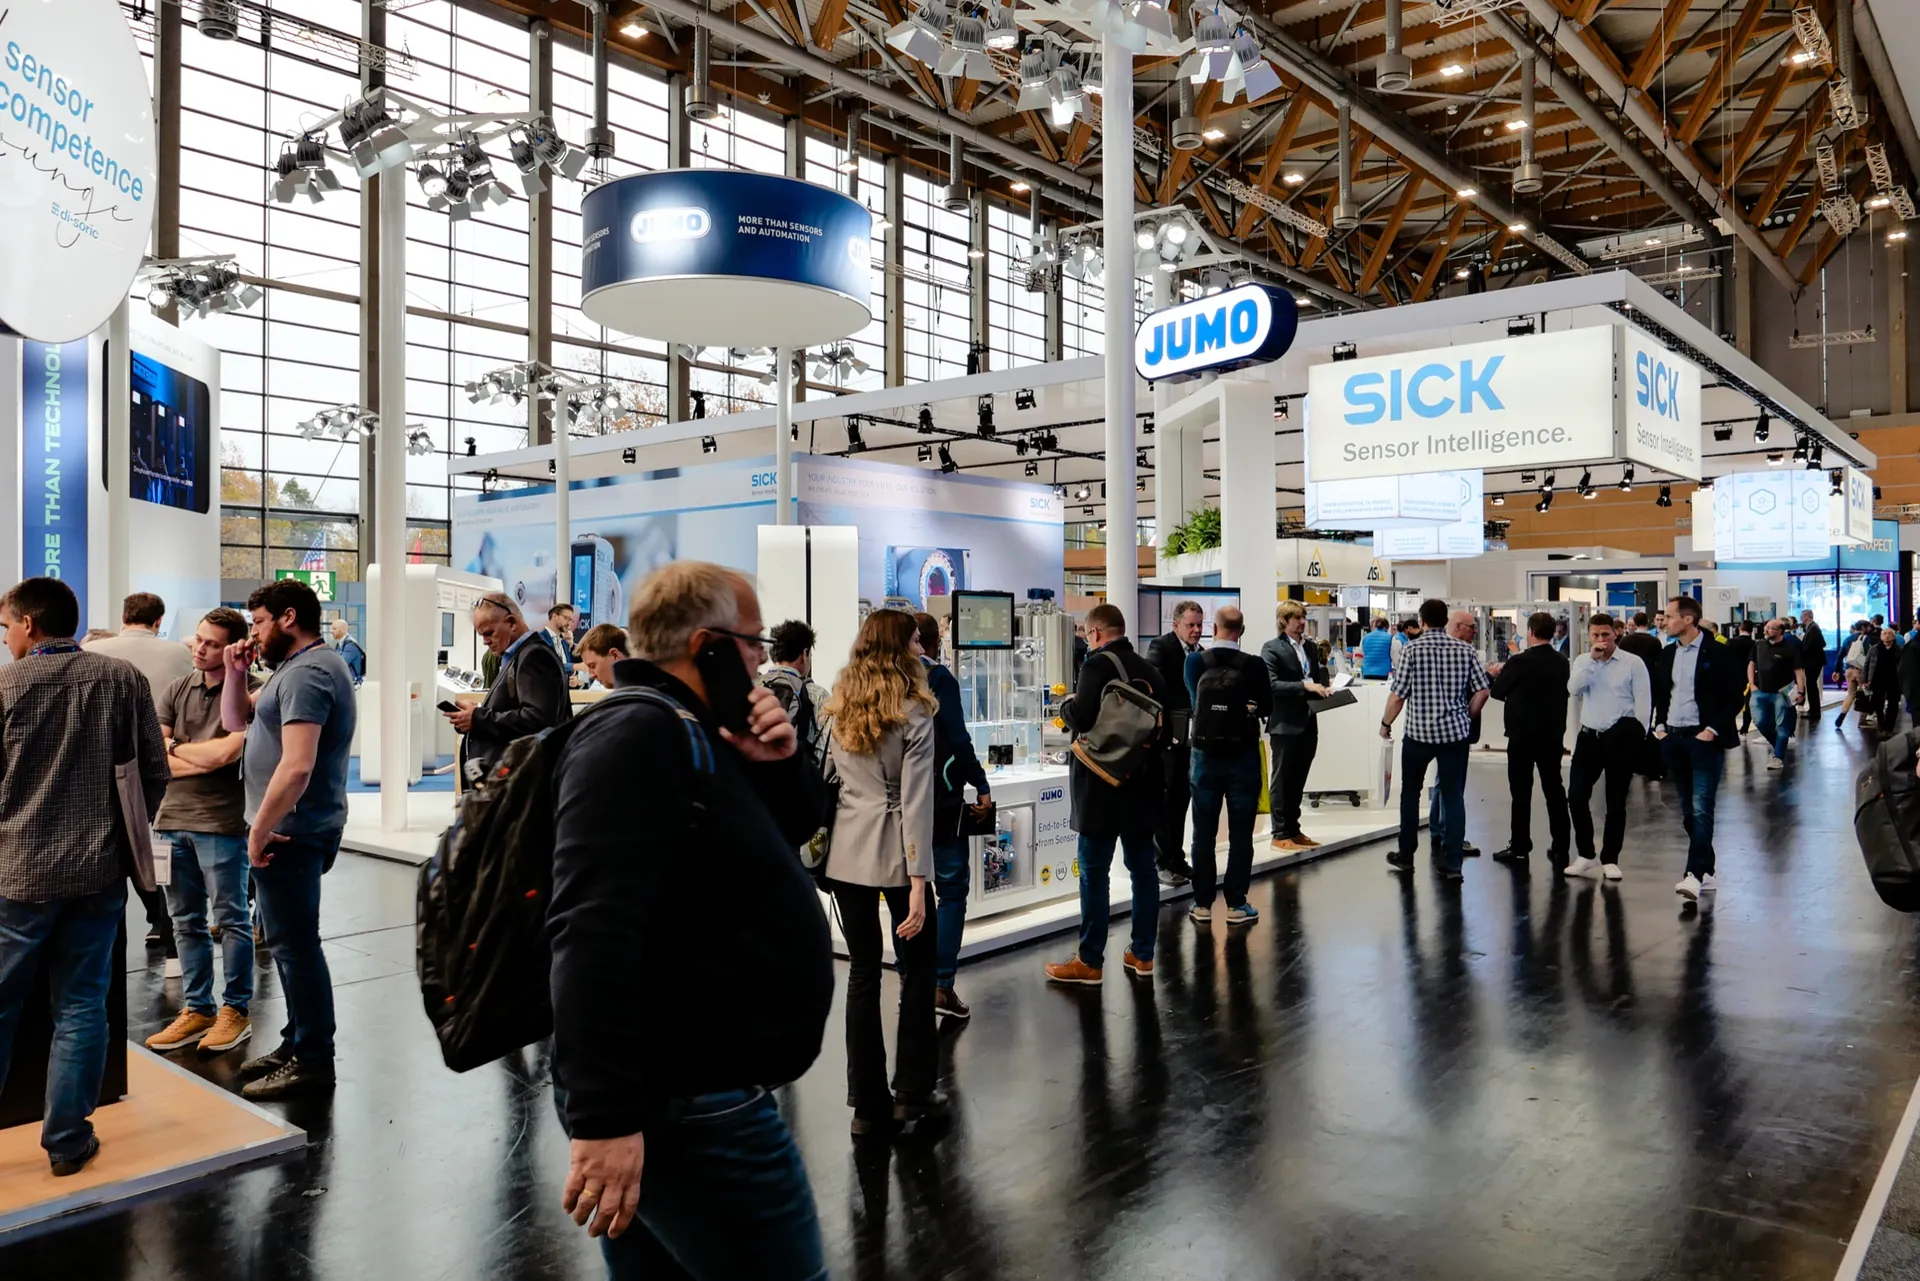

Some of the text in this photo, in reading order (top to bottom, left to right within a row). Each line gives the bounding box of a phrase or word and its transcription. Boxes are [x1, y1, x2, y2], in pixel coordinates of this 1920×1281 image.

[5, 41, 94, 123] sensor
[0, 80, 143, 201] competence
[60, 208, 99, 239] di-soric
[738, 215, 823, 237] MORE THAN SENSORS
[738, 226, 810, 243] AND AUTOMATION
[1144, 299, 1258, 366] JUMO
[1343, 355, 1505, 425] SICK
[1635, 350, 1680, 422] SICK
[1343, 427, 1572, 463] Sensor Intelligence.
[1636, 422, 1660, 450] Sensor
[45, 458, 61, 526] THAN
[751, 471, 777, 487] SICK
[1030, 497, 1050, 510] SICK
[45, 533, 61, 580] ORE
[1041, 789, 1062, 801] JUMO
[1039, 818, 1070, 832] End-to-En
[1039, 833, 1078, 848] from Sensor
